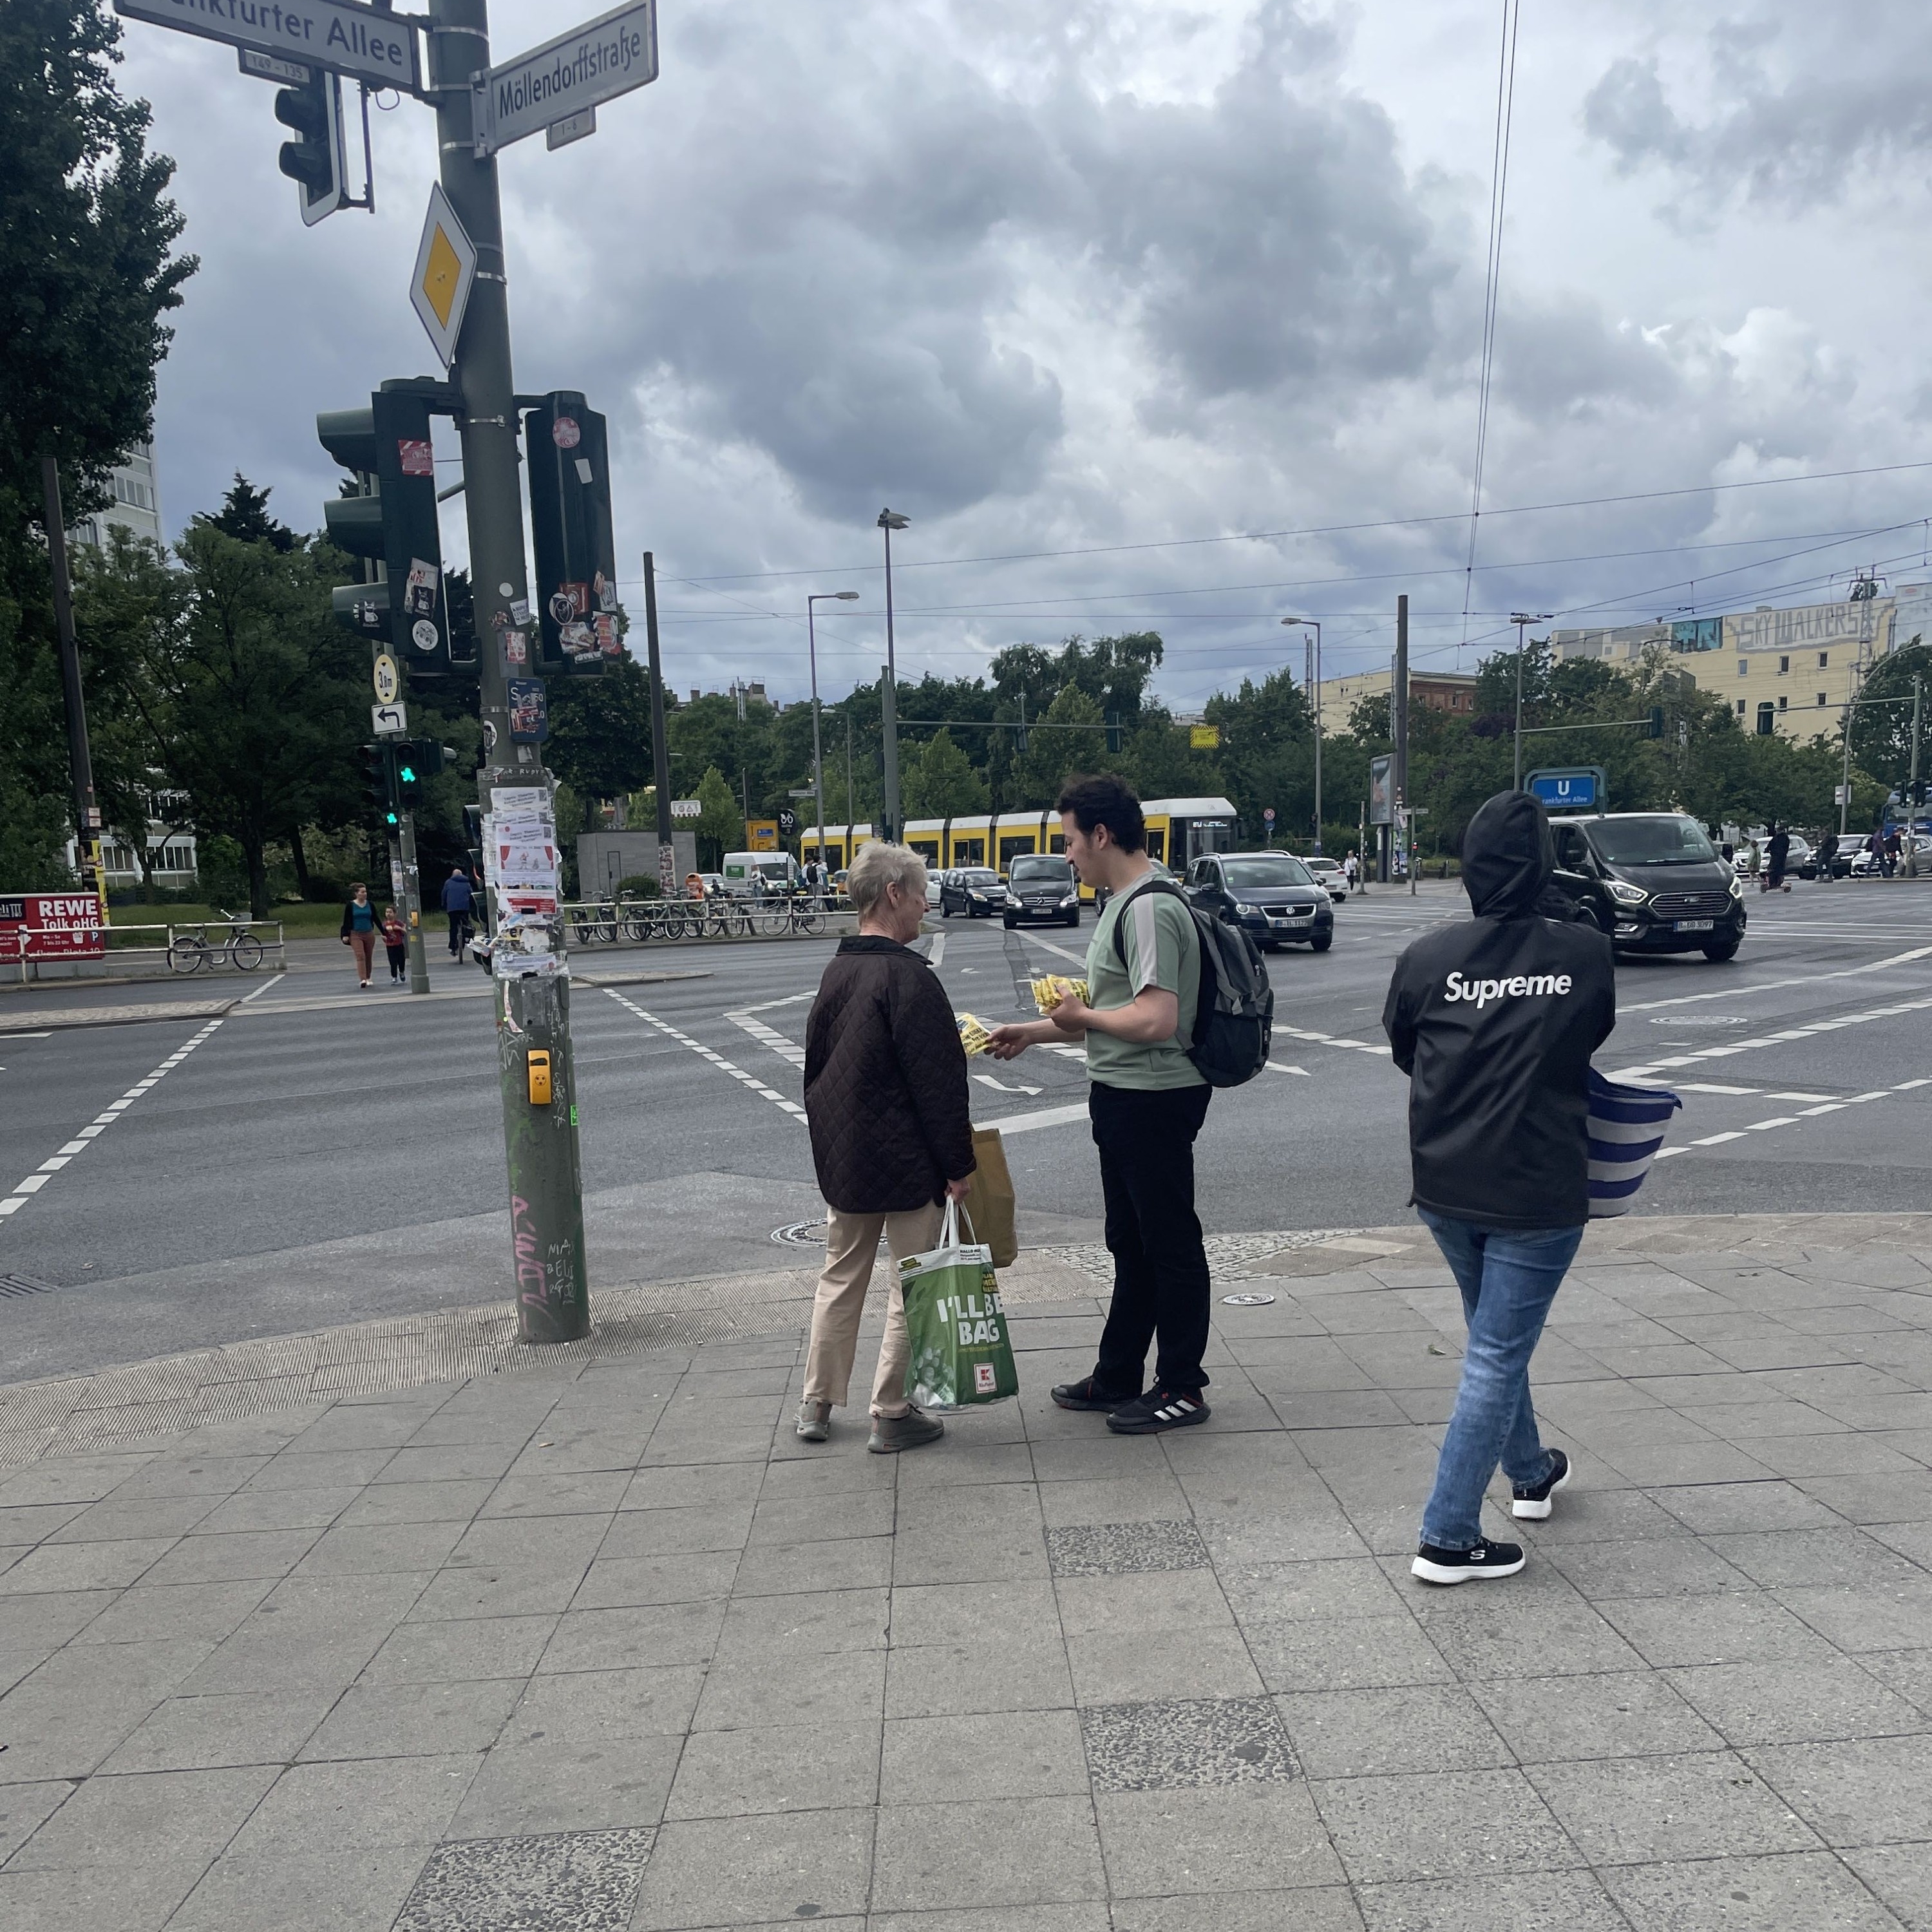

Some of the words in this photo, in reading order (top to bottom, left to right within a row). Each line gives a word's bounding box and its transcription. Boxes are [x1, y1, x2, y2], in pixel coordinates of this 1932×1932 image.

[327, 17, 402, 66] Allee
[284, 63, 303, 79] 135
[499, 25, 641, 119] Möllendorffstraße
[1558, 780, 1570, 796] U
[38, 899, 99, 917] REWE
[41, 918, 69, 930] Tolk
[91, 932, 99, 942] P
[1443, 971, 1572, 1009] Supreme
[936, 1294, 984, 1323] I'LL
[958, 1318, 1000, 1345] BAG
